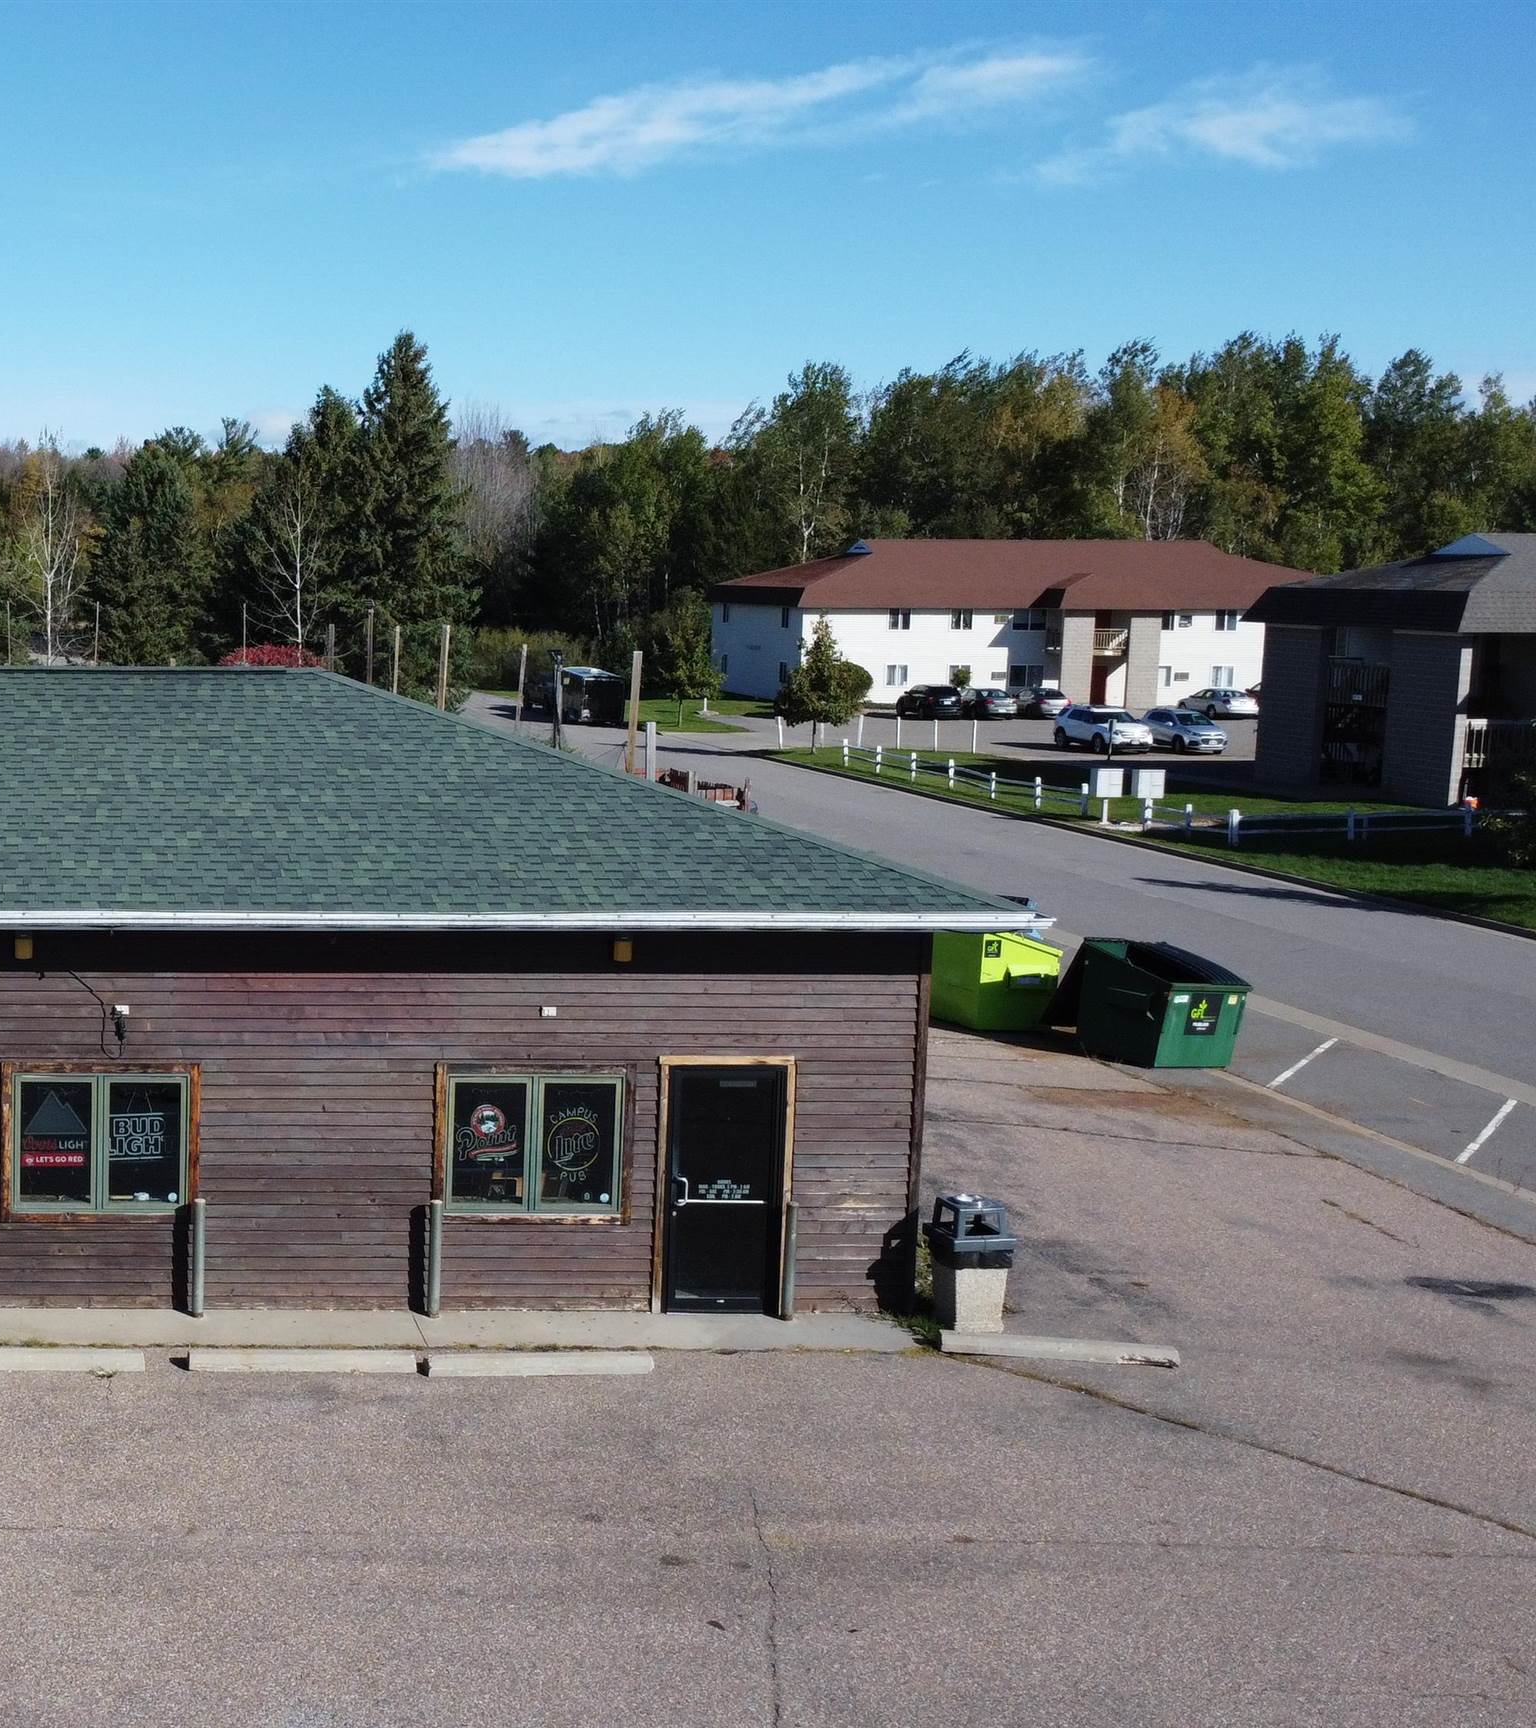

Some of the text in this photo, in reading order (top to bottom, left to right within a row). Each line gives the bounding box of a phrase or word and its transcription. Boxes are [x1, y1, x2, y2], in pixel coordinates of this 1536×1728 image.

[550, 1107, 598, 1124] CAMPUS
[114, 1117, 166, 1136] BUD
[456, 1125, 518, 1160] Point
[35, 1155, 84, 1163] LET'S GO RED
[559, 1170, 587, 1182] PUB
